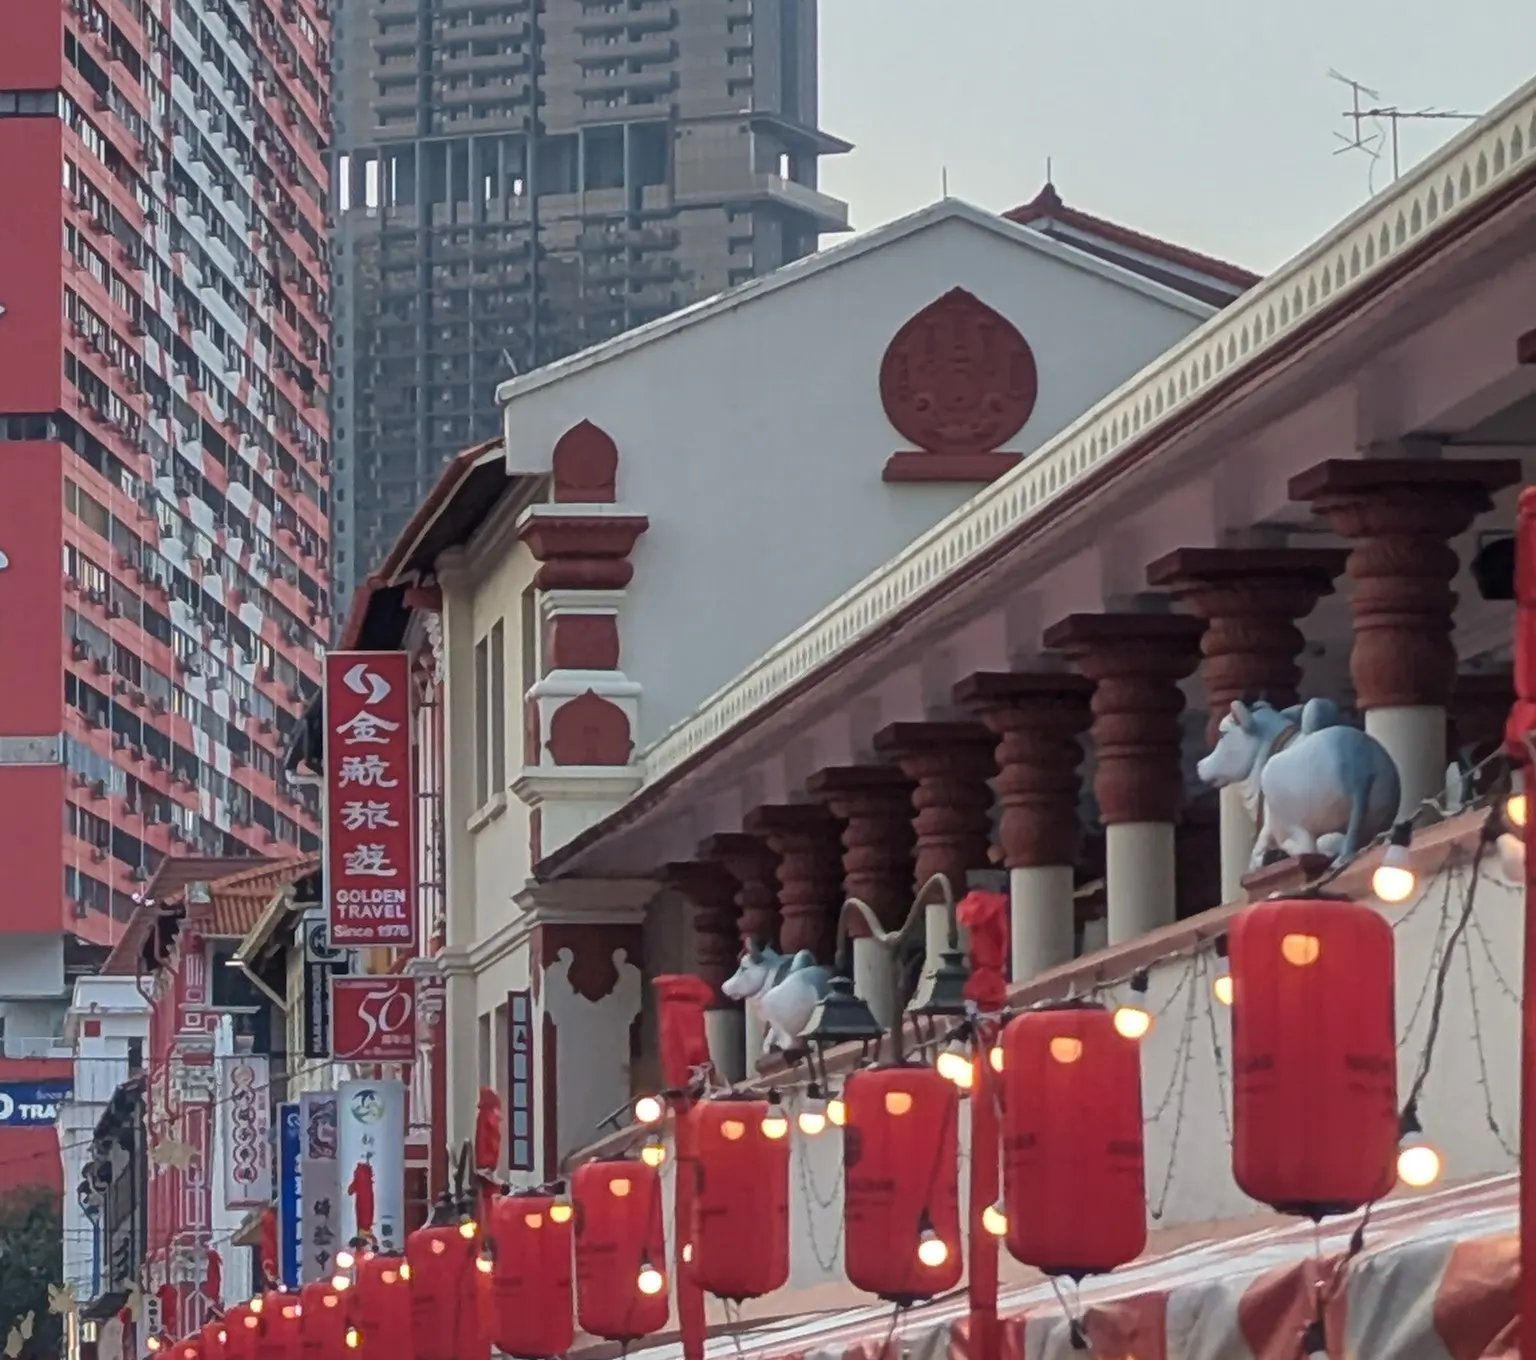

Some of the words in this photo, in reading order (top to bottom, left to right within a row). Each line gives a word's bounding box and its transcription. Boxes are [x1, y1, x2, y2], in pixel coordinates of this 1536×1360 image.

[335, 888, 407, 904] GOLDEN
[336, 904, 407, 920] TRAVEL
[333, 924, 375, 938] Since
[18, 1103, 61, 1120] TRA
